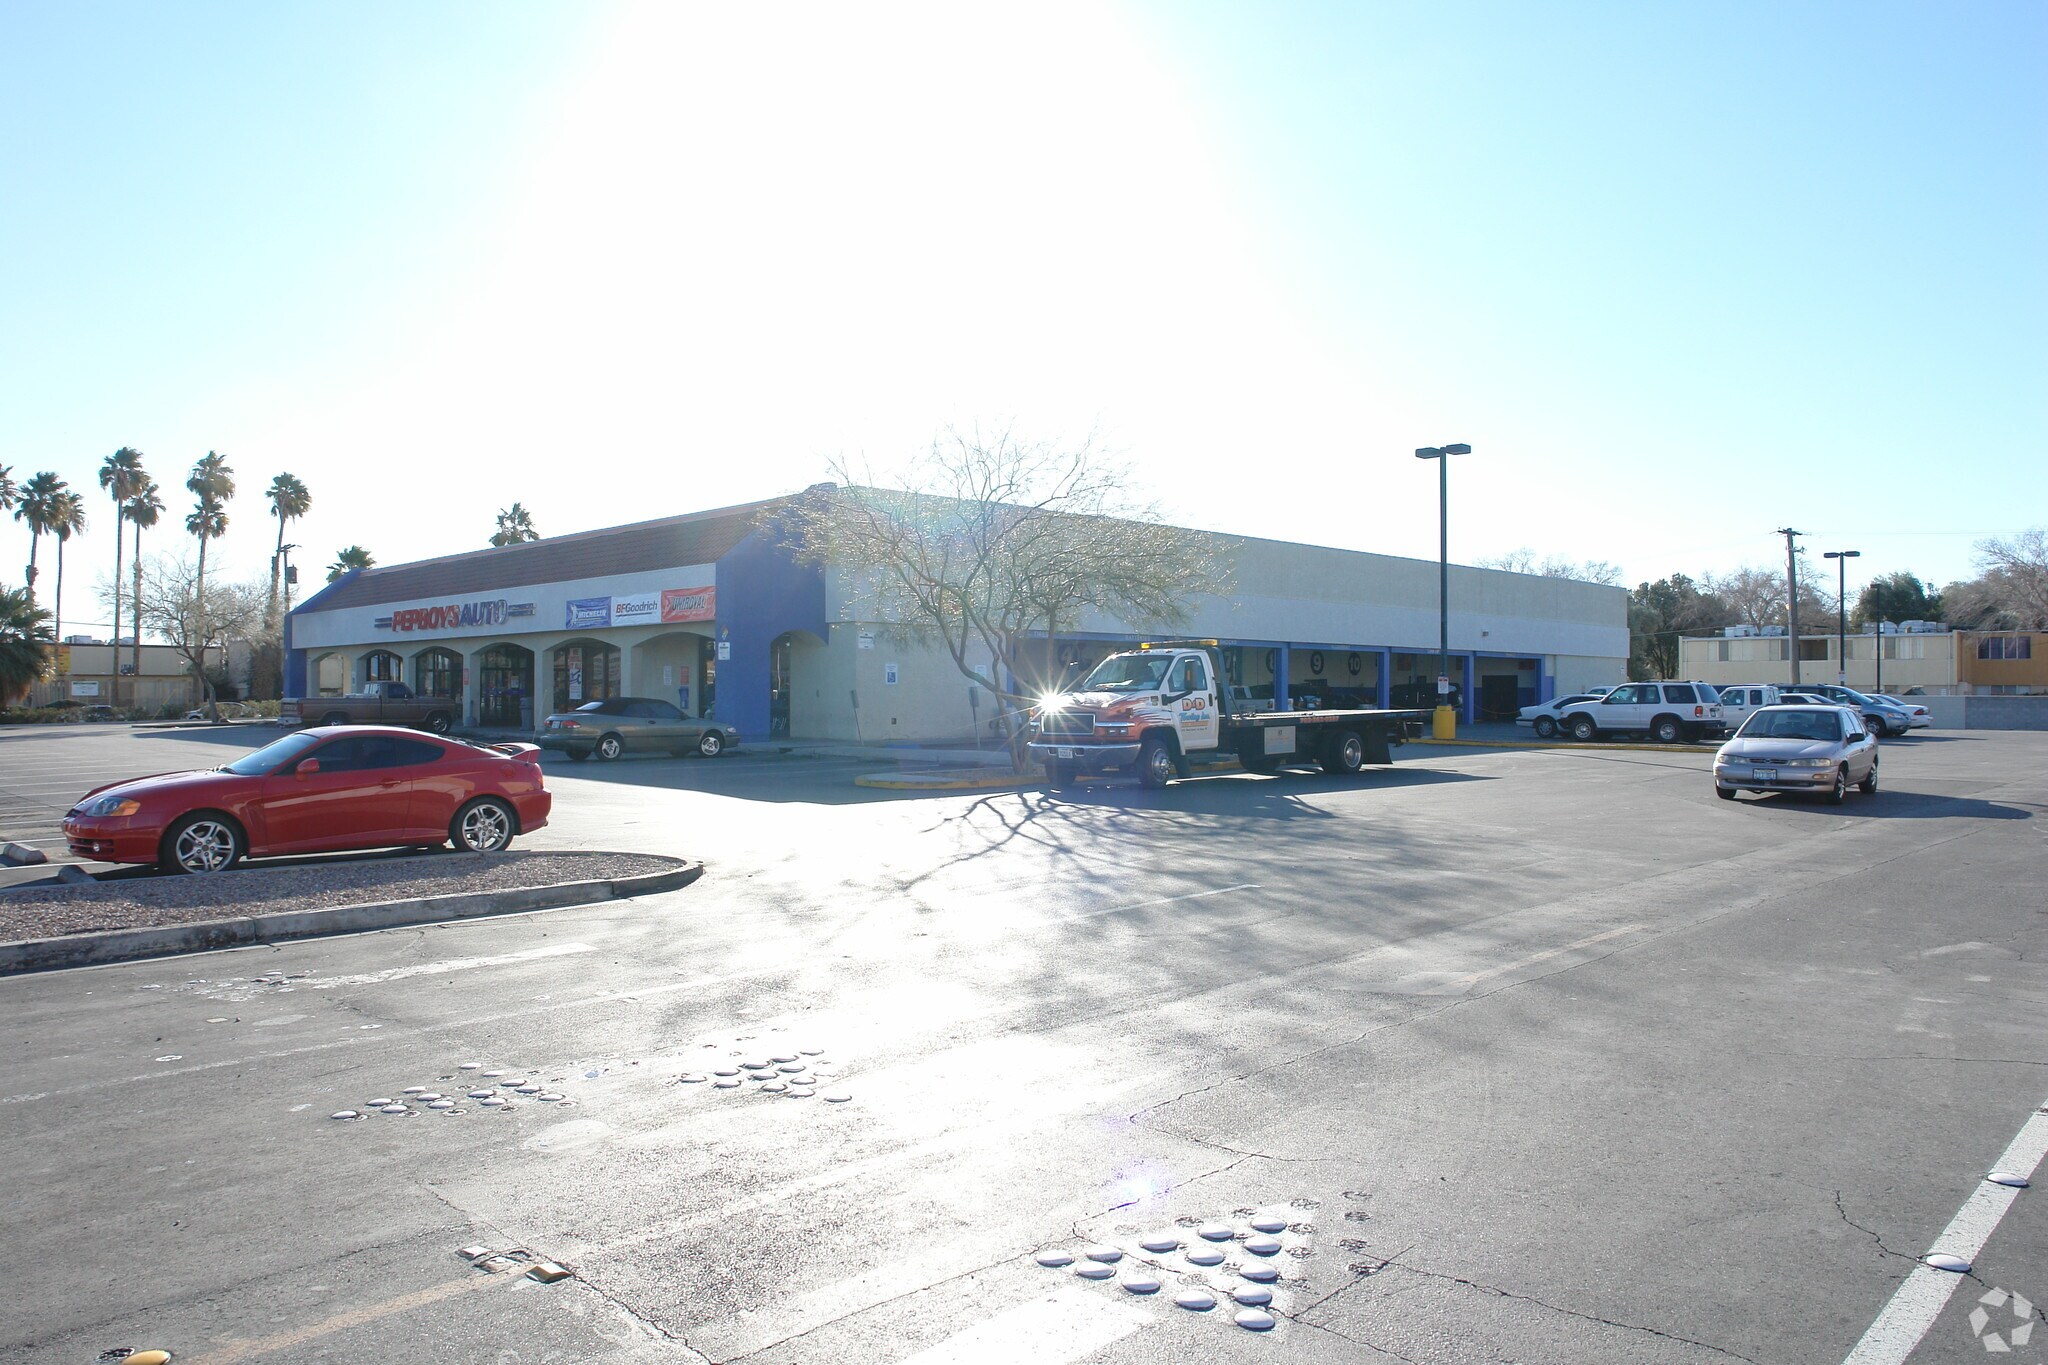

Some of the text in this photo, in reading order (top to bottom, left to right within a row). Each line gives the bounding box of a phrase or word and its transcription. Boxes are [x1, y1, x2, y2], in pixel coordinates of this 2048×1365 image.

[459, 599, 509, 626] AUTO
[577, 608, 607, 619] MICHELIN
[615, 600, 658, 614] BFGoodrich
[1313, 655, 1322, 671] 9
[1348, 657, 1360, 671] 10
